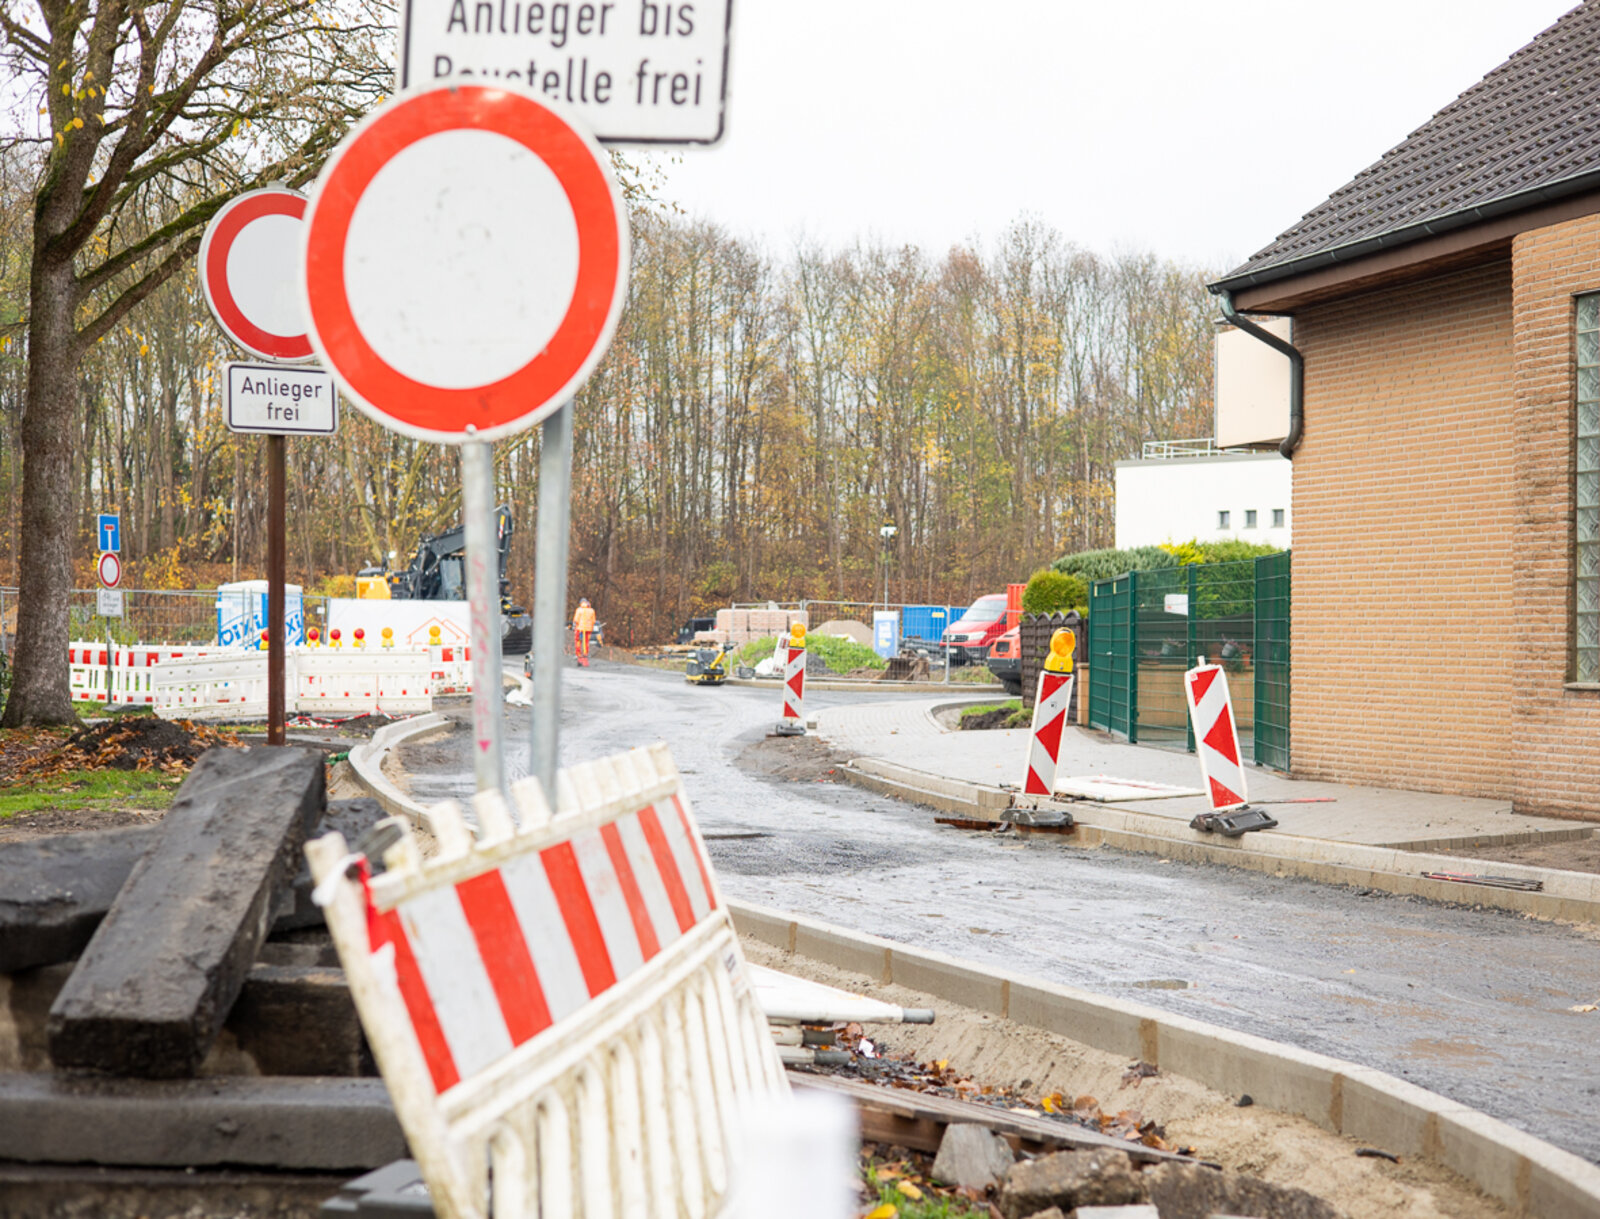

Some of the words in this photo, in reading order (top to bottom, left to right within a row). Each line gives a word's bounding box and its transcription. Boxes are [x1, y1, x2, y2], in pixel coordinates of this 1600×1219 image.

[447, 0, 614, 48] Anlieger
[639, 0, 696, 36] bis
[636, 58, 704, 106] frei
[241, 376, 322, 402] Anlieger
[267, 402, 299, 421] frei
